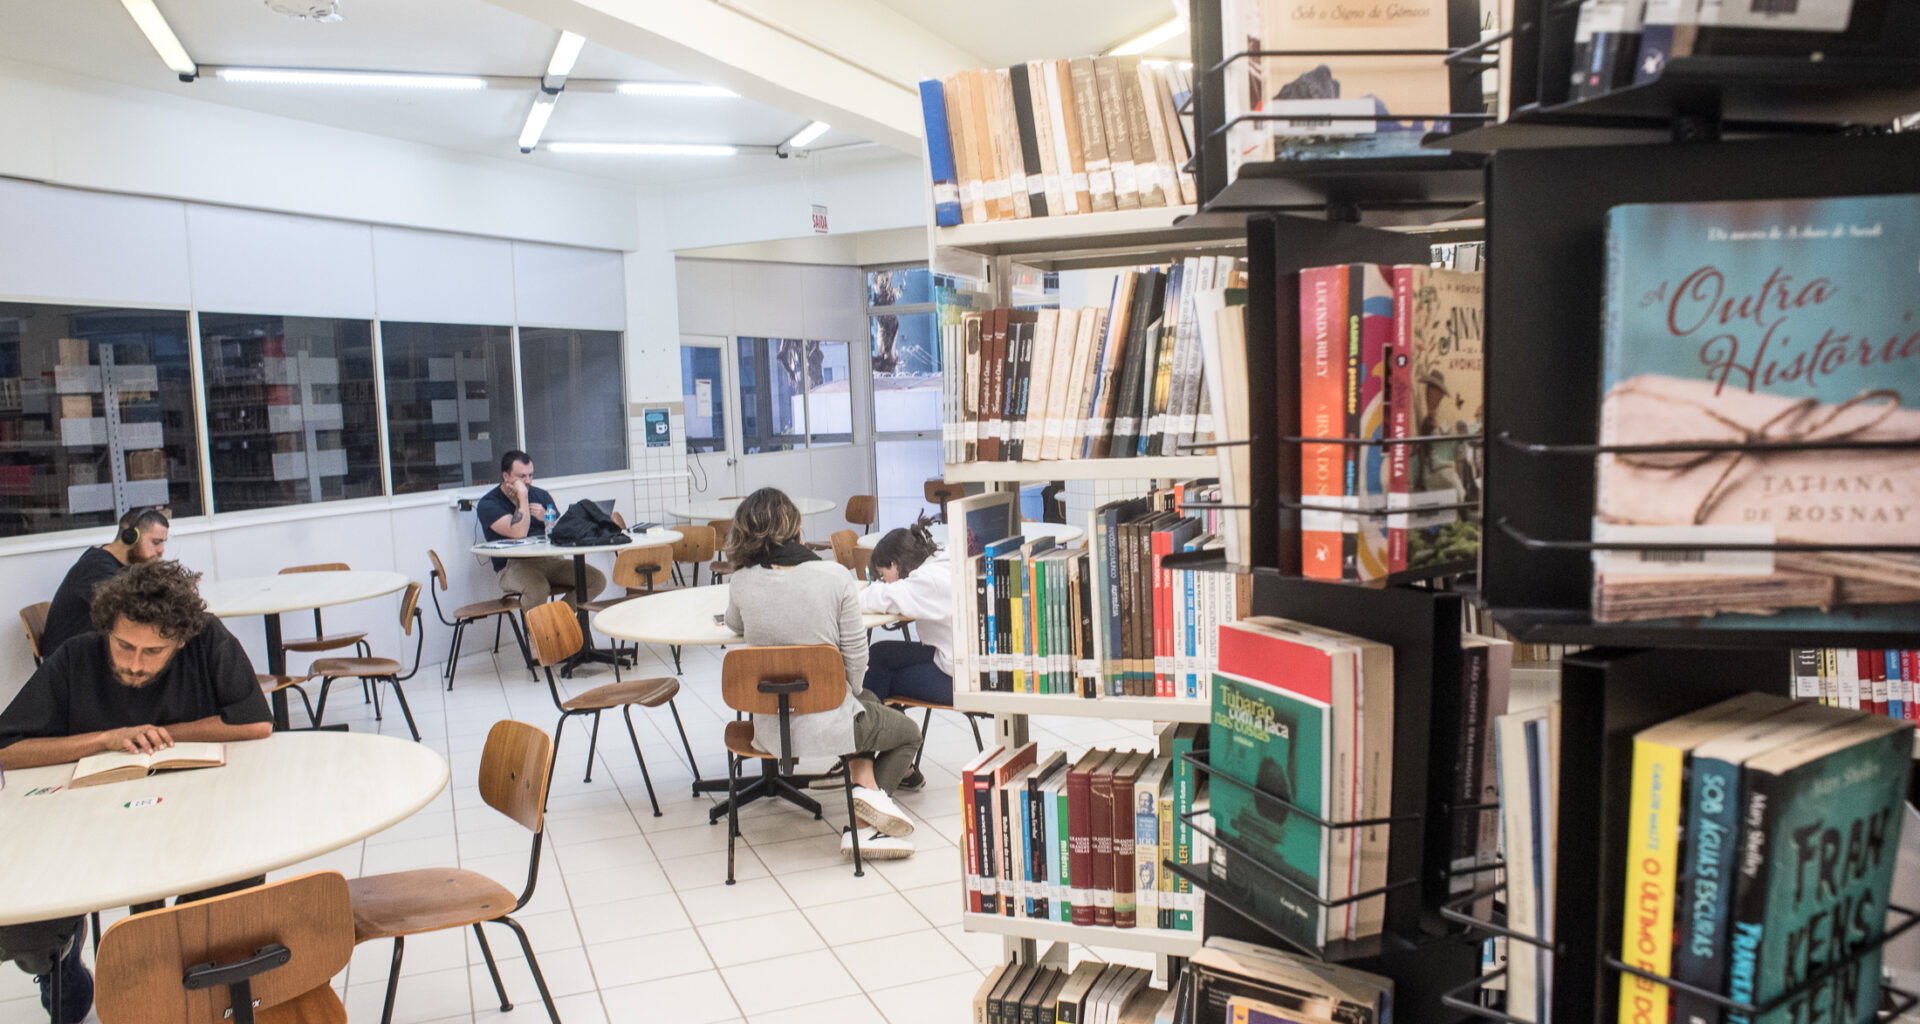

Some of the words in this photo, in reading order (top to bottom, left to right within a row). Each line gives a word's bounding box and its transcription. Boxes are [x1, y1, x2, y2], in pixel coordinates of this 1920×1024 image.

[1315, 281, 1328, 340] LUCINDA
[1667, 265, 1838, 336] Outra
[1316, 341, 1328, 378] RILEY
[1762, 474, 1895, 495] TATIANA
[1743, 505, 1770, 522] DE
[1786, 504, 1911, 525] ROSNAY
[1214, 711, 1233, 729] nas
[1219, 684, 1275, 721] Tubarão
[1264, 715, 1289, 739] faca
[1700, 773, 1726, 814] SOB
[1745, 792, 1767, 827] Mary
[1642, 858, 1661, 876] O
[1695, 817, 1729, 878] ÁGUAS
[1742, 829, 1766, 879] Shelley
[1793, 806, 1892, 913] FRAN
[1637, 881, 1665, 954] ÚLTIMO
[1690, 879, 1718, 959] ESCURAS
